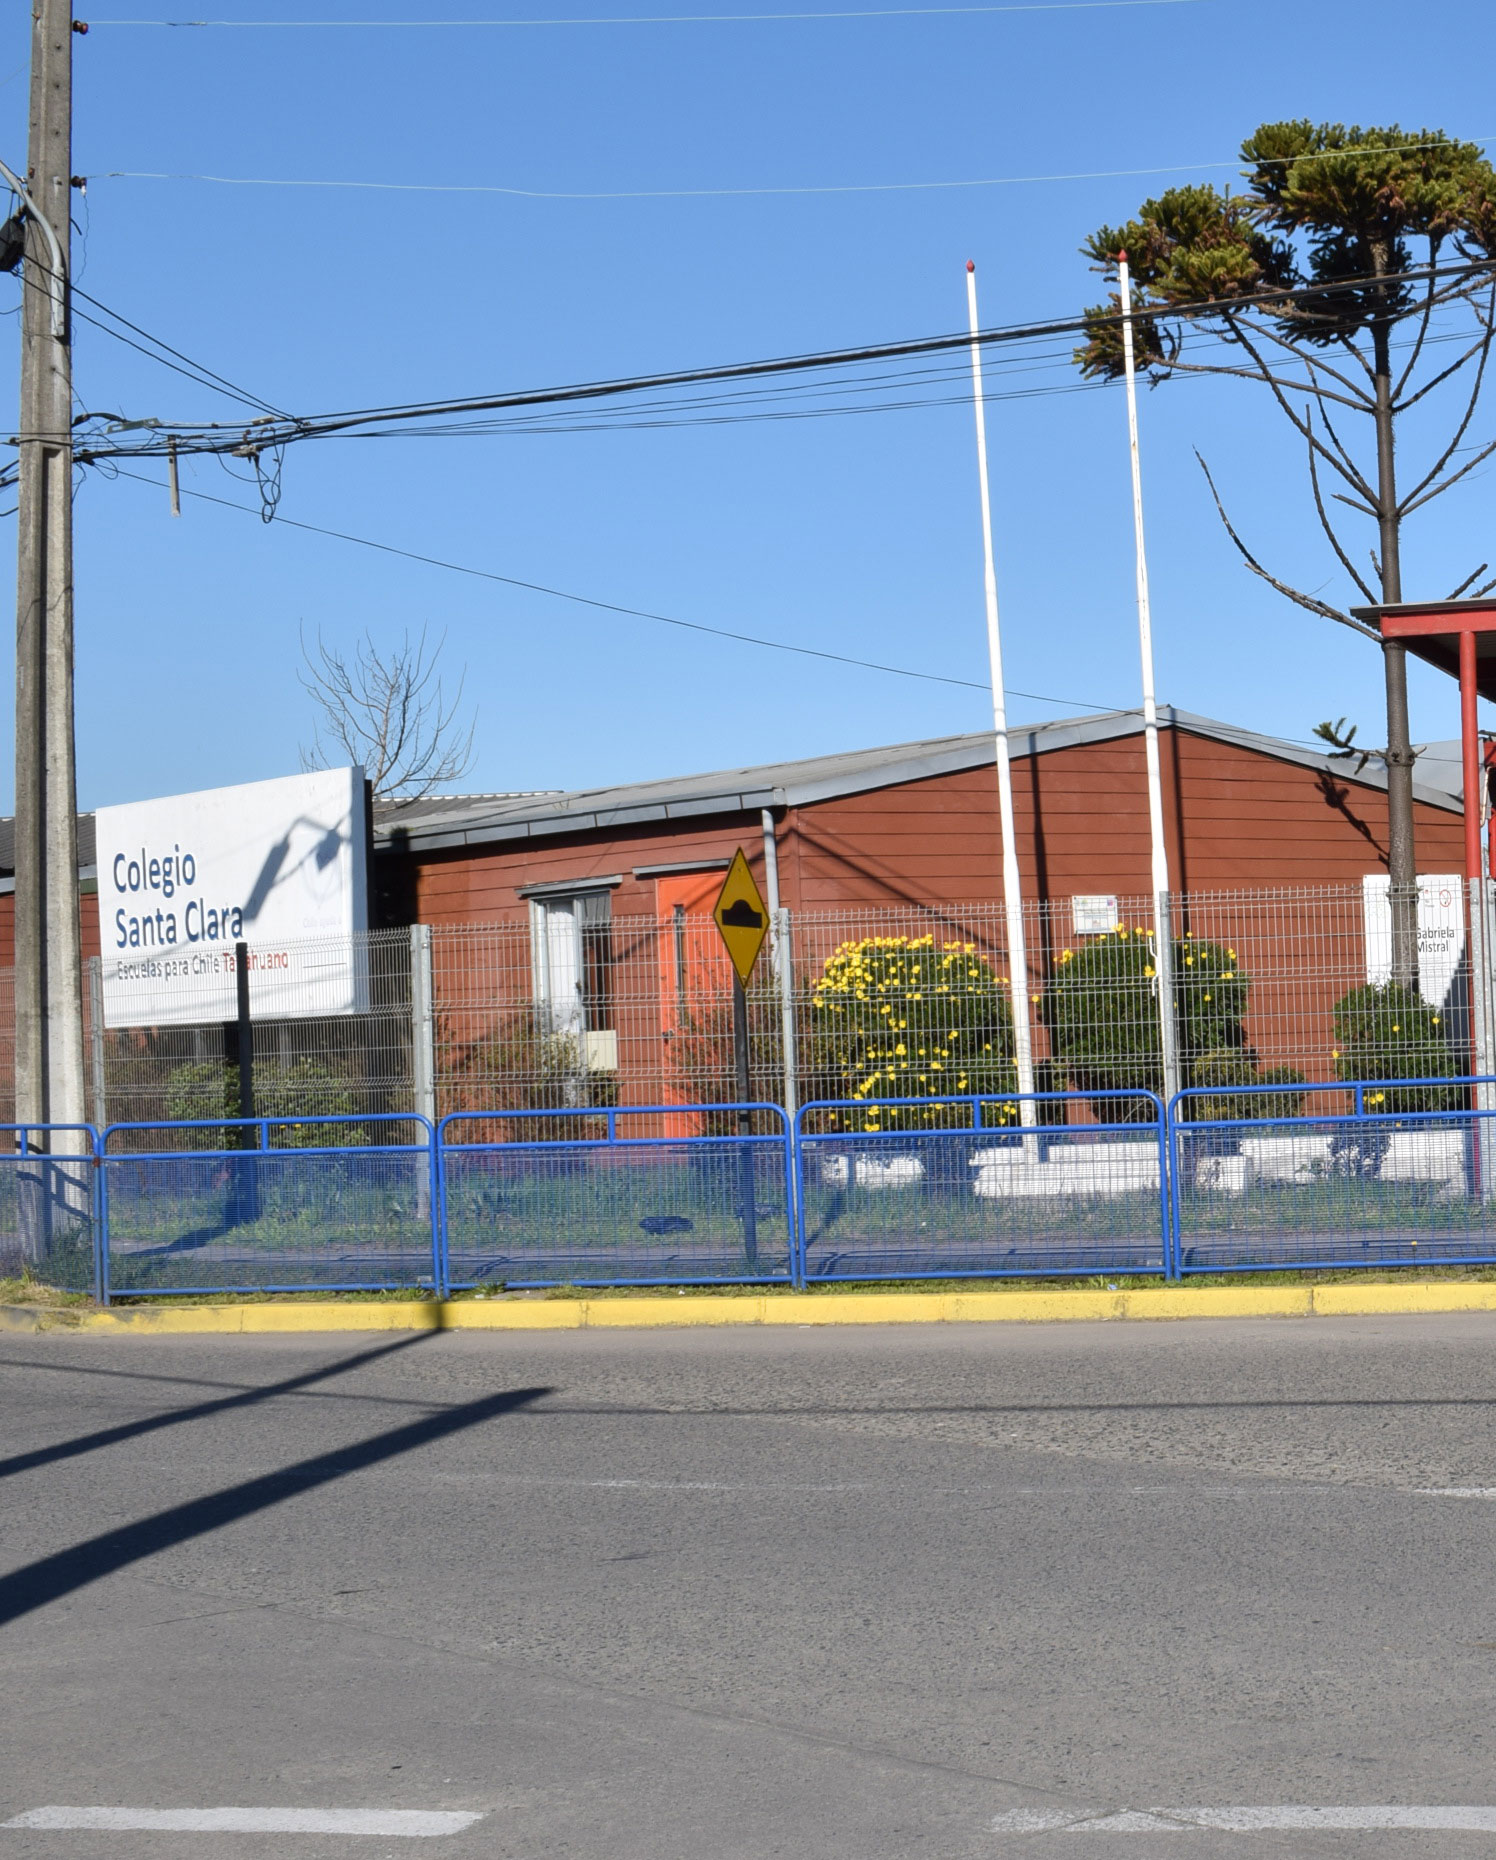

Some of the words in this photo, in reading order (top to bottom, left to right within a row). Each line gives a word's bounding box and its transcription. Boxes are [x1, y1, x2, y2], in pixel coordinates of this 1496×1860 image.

[113, 844, 196, 898] Colegio
[116, 908, 177, 948] Santa
[185, 898, 243, 942] Clara
[117, 960, 162, 980] Escuelas
[165, 958, 189, 981] para
[192, 952, 219, 974] Chile
[223, 950, 288, 972] Taahuano
